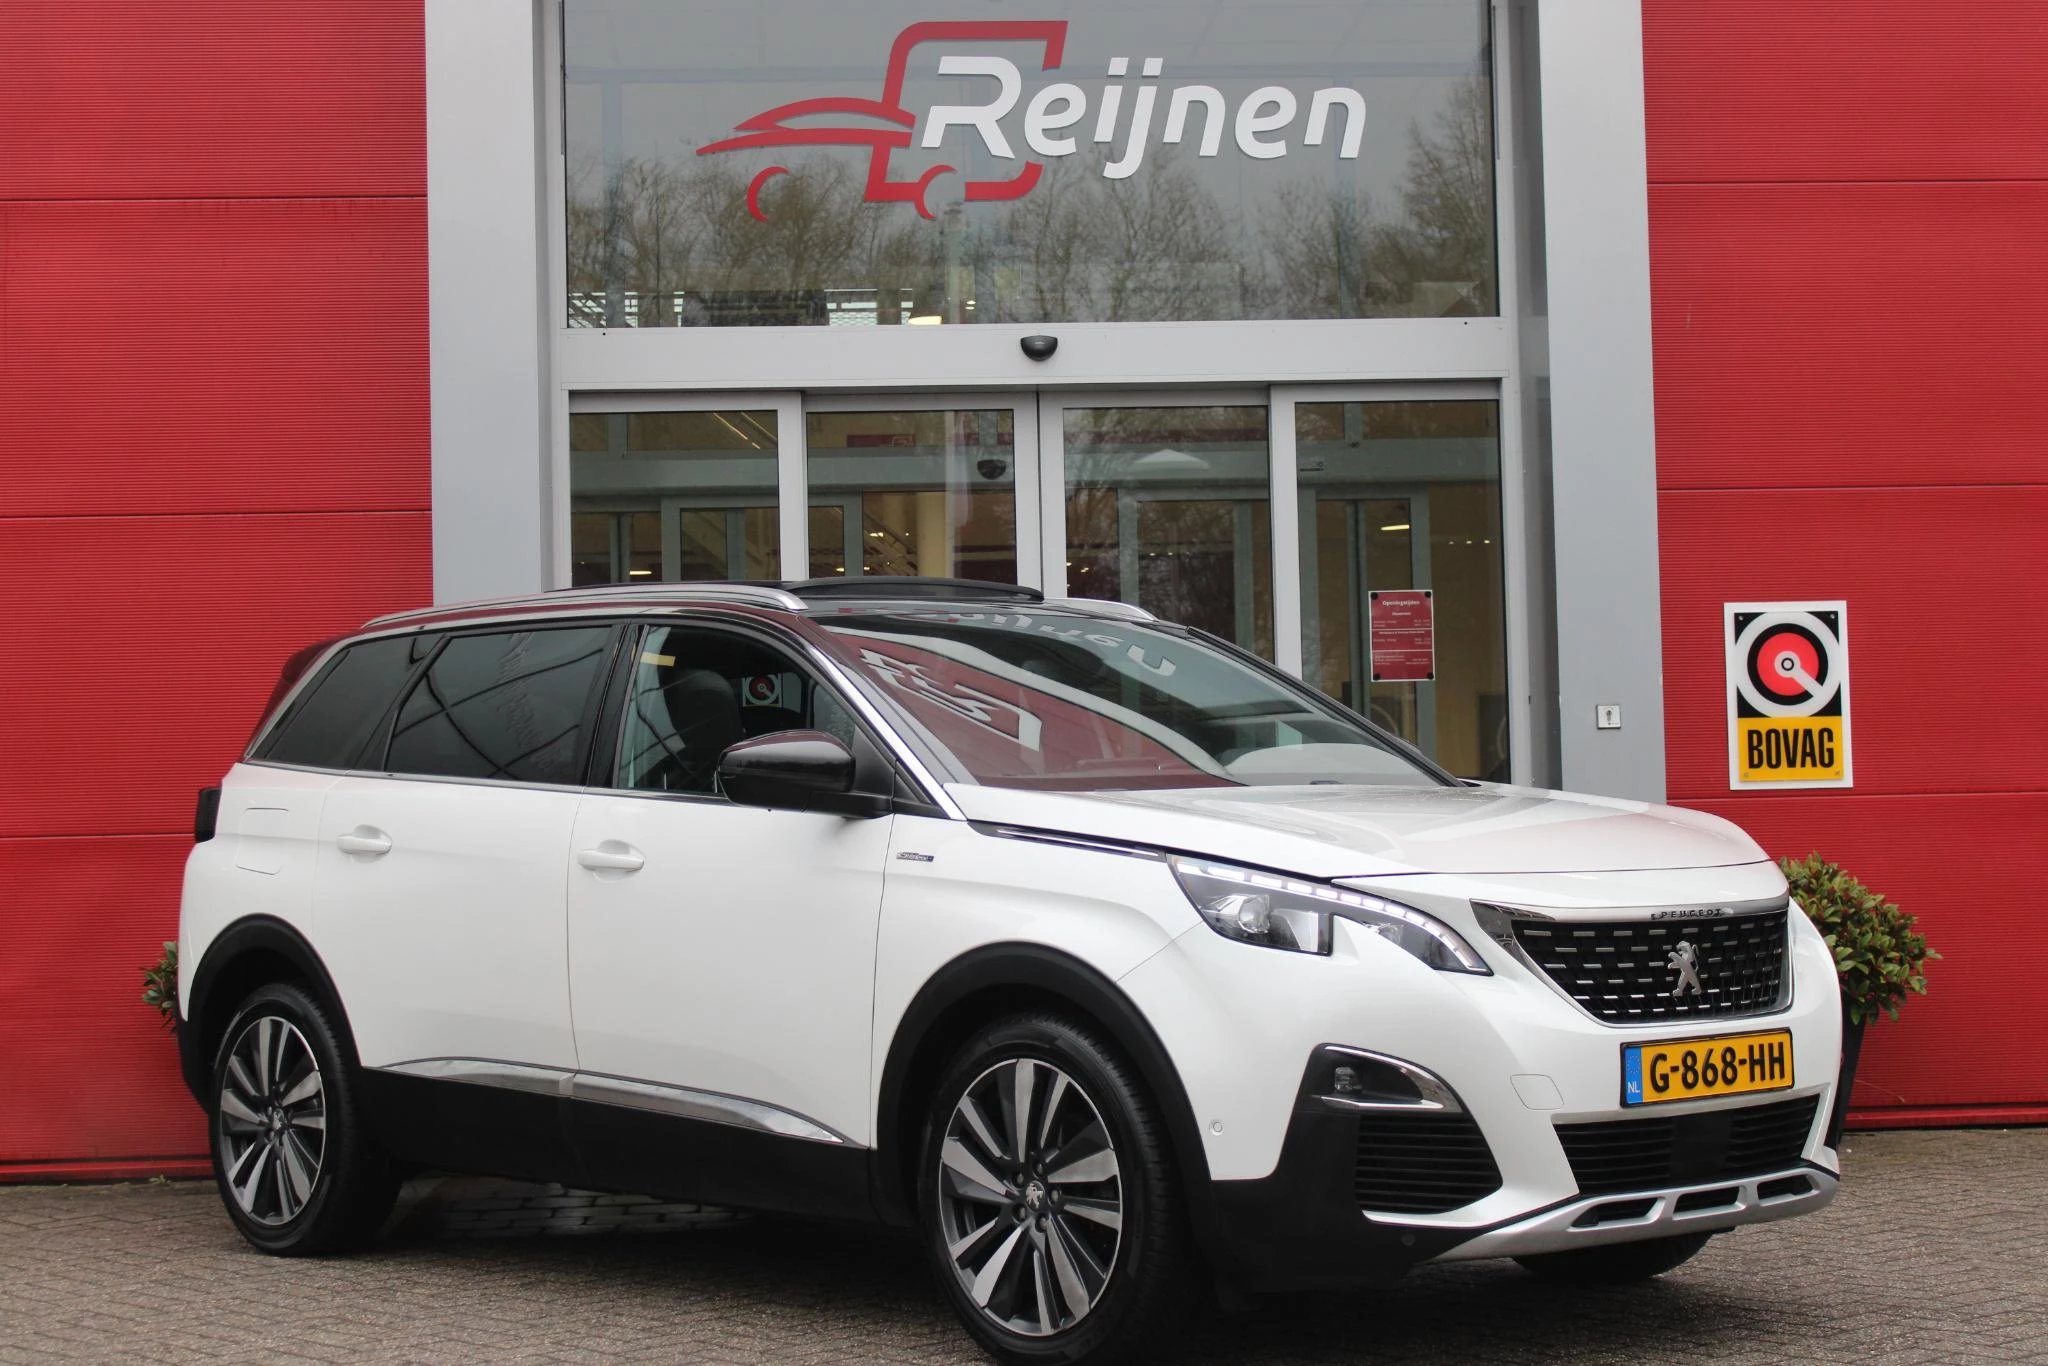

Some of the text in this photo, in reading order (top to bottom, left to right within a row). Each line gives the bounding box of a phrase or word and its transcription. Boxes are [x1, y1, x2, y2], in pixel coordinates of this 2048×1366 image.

[921, 56, 1366, 179] Reijnen
[1747, 727, 1835, 769] BOVAG
[1661, 908, 1722, 919] PEUGEOT
[1627, 1042, 1785, 1093] NL G-868-HH
